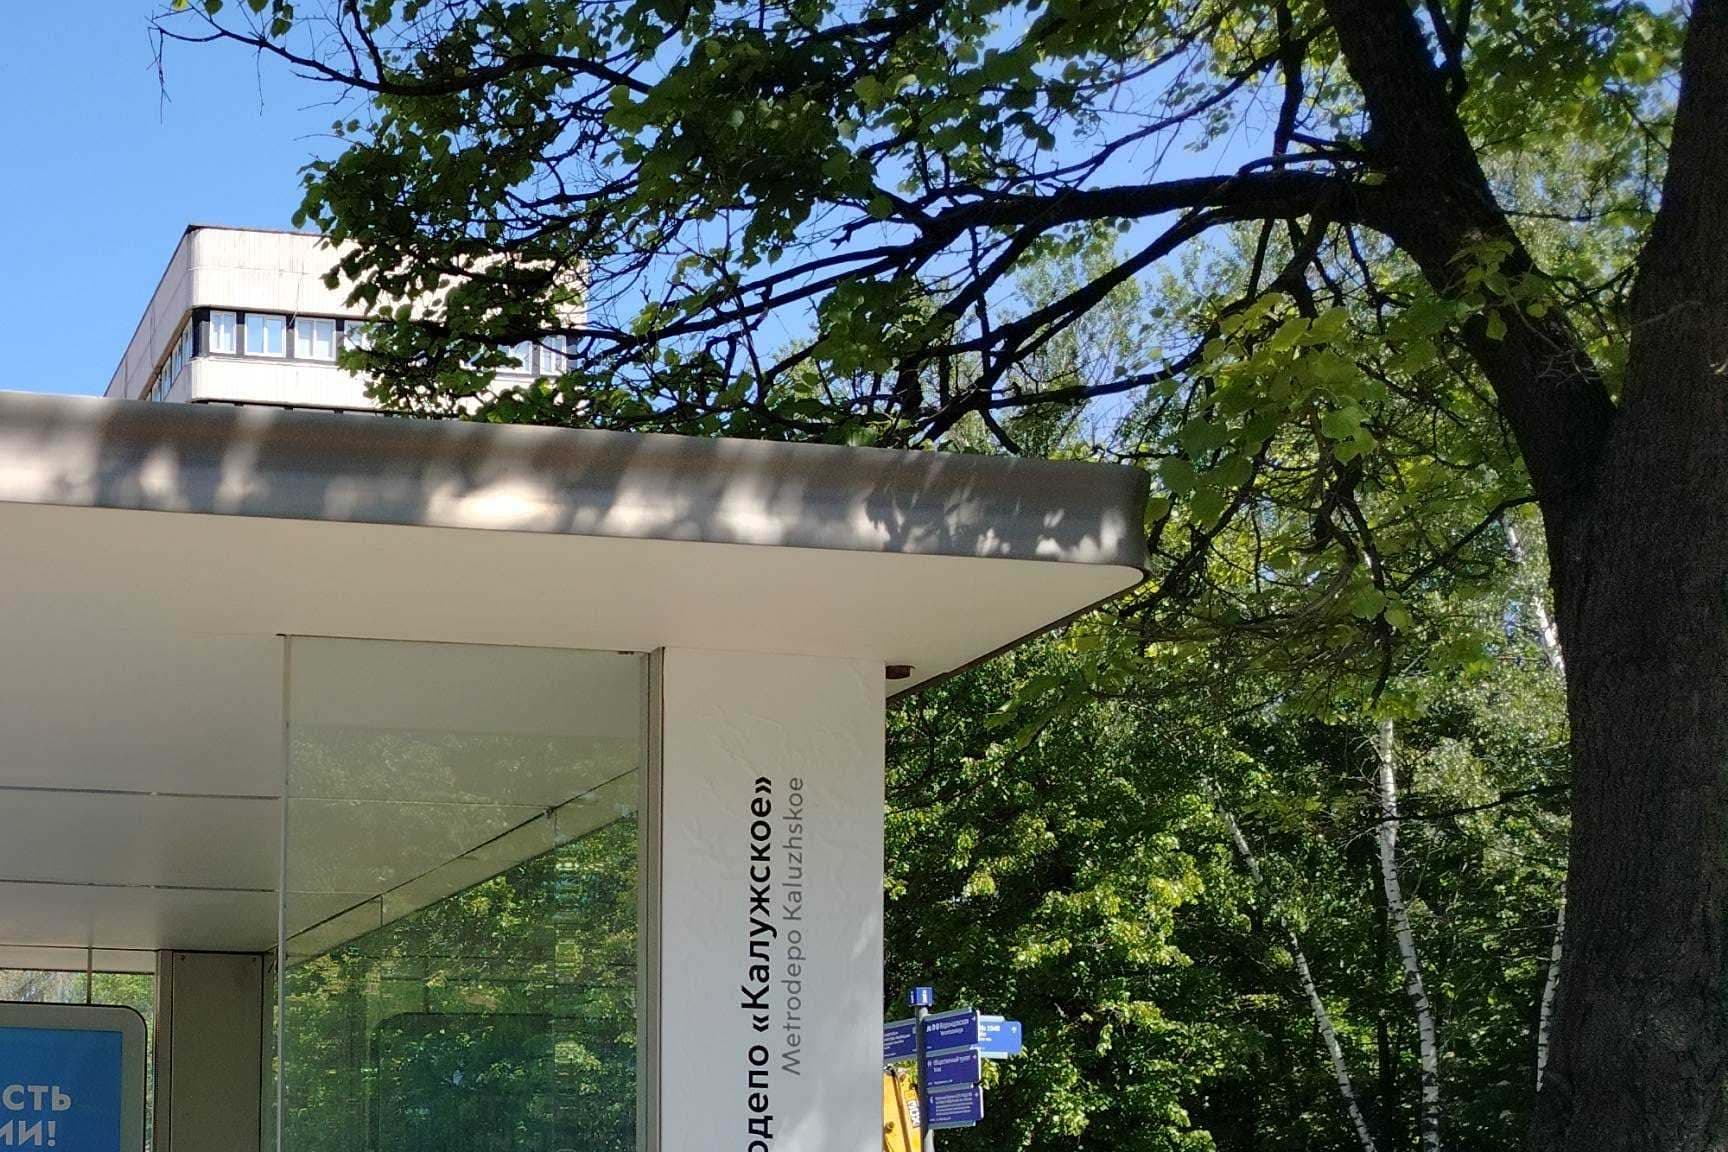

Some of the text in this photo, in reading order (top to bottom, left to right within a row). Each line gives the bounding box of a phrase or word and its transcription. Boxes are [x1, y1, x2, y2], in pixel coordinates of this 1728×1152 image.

[741, 776, 777, 1032] «Калужское»
[781, 777, 806, 1076] Metrodepo Kaluzhskoe
